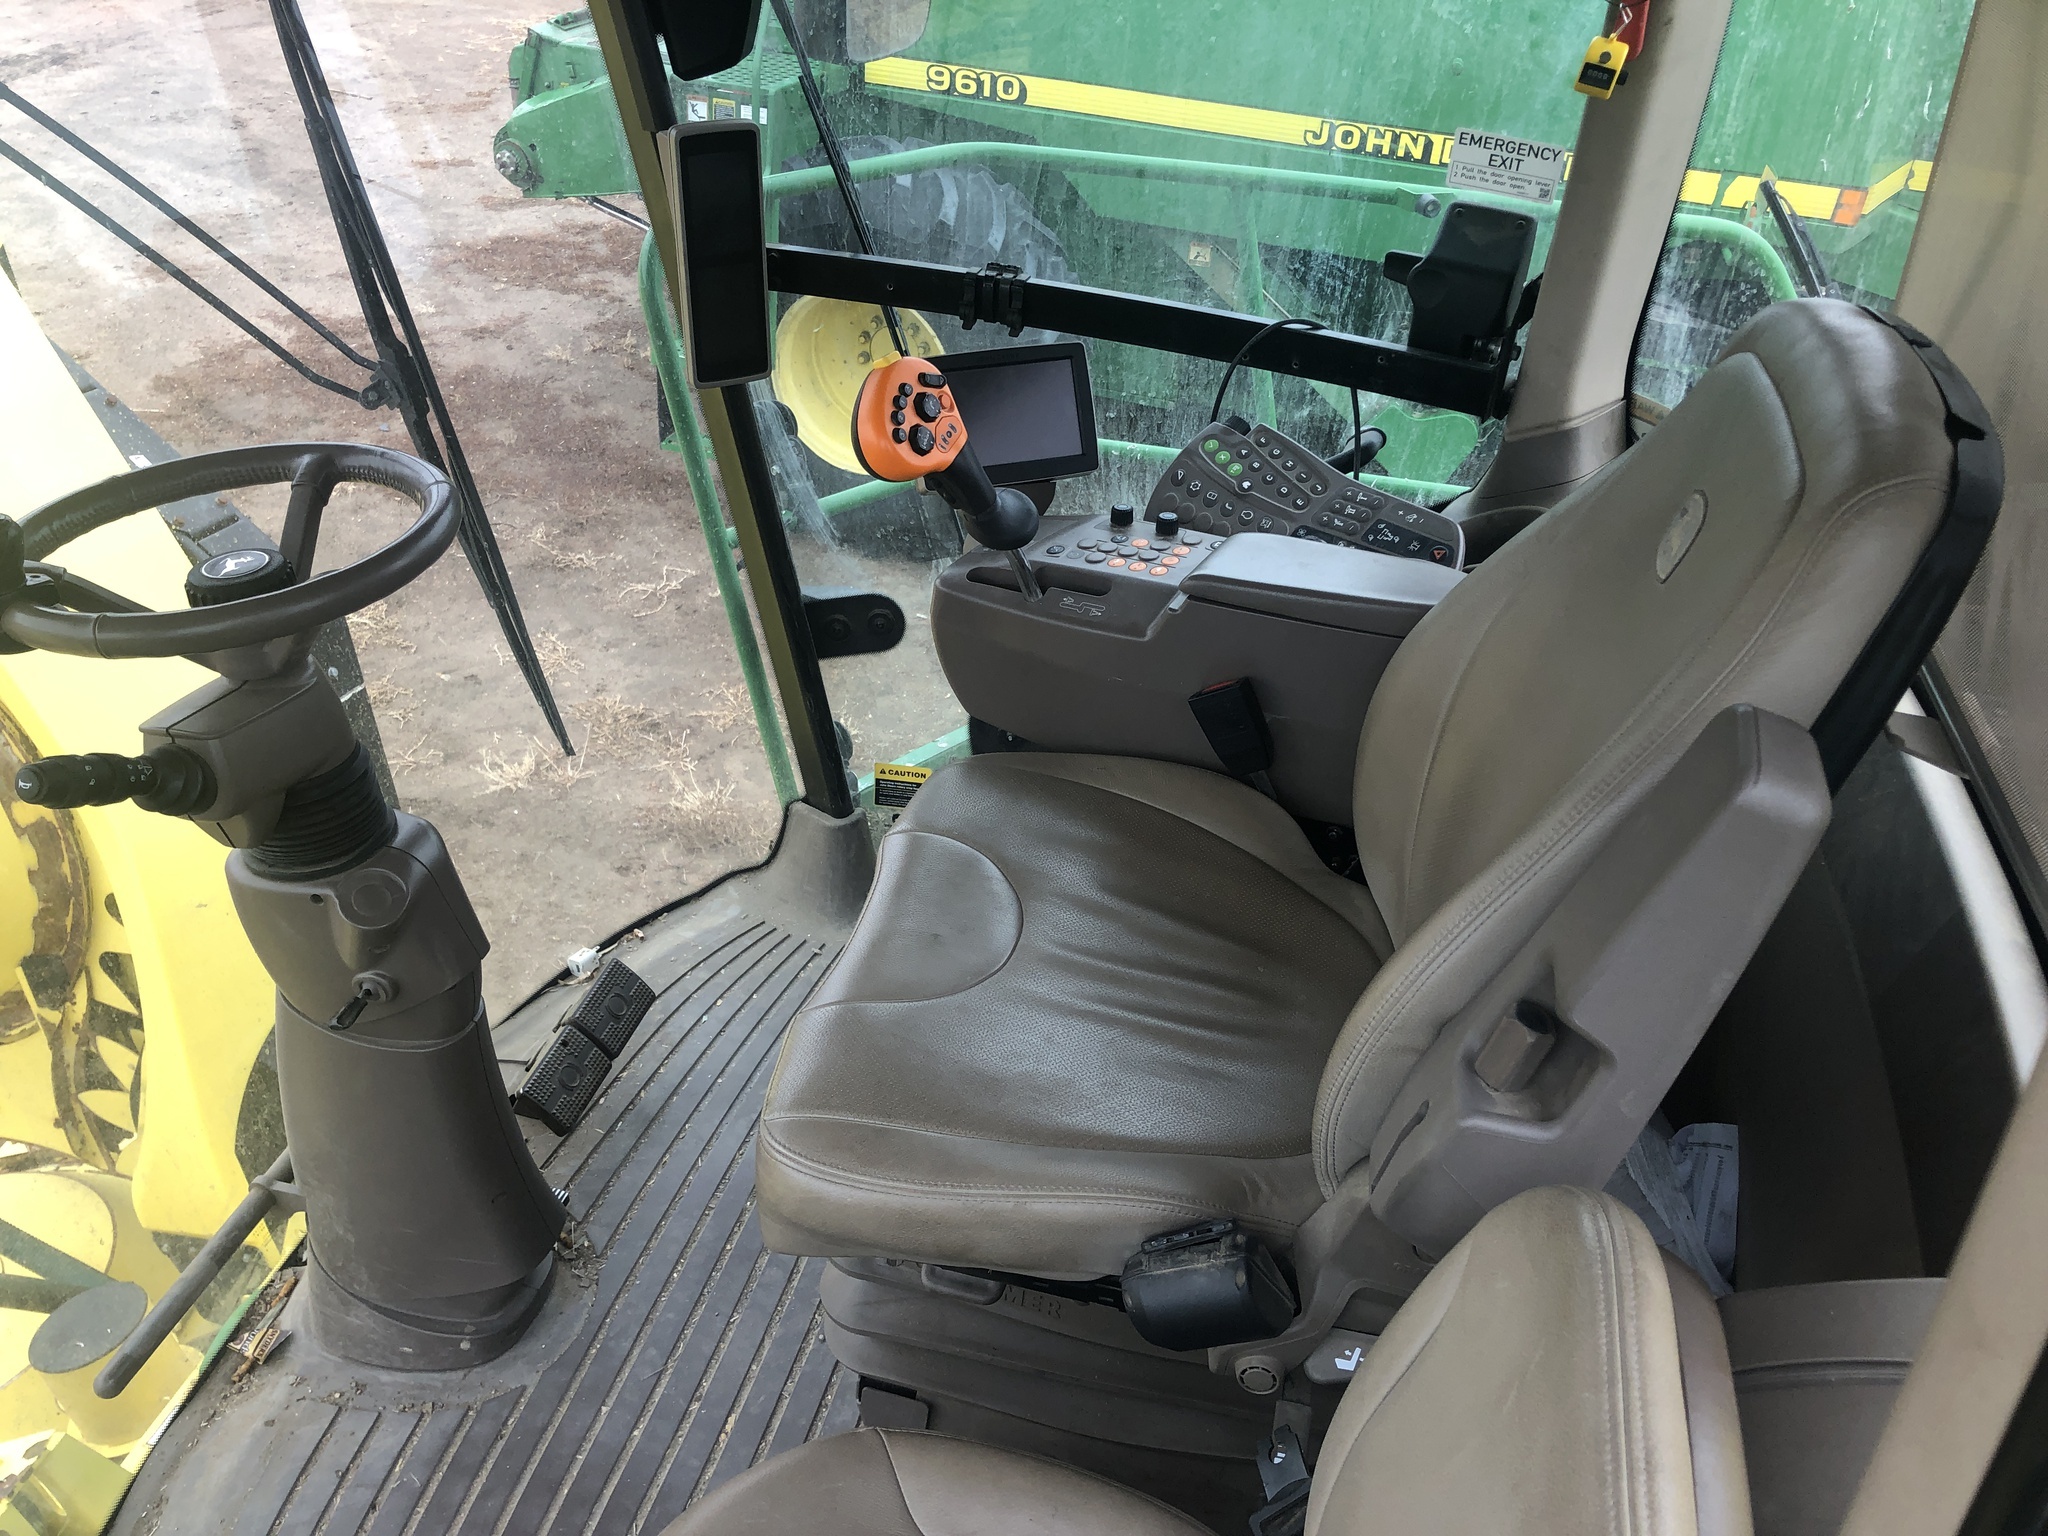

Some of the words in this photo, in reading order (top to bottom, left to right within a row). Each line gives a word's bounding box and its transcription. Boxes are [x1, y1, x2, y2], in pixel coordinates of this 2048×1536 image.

[926, 64, 1022, 102] 9610
[1305, 120, 1426, 161] JOHN
[1458, 132, 1562, 162] EMERGENCY
[1488, 154, 1525, 172] EXIT
[1460, 172, 1477, 180] Push
[1479, 175, 1489, 183] the
[1492, 177, 1507, 186] door
[1461, 165, 1475, 173] Pull
[1477, 168, 1487, 176] the
[1490, 170, 1505, 179] door
[1507, 175, 1533, 186] opening
[888, 769, 927, 779] CAUTION
